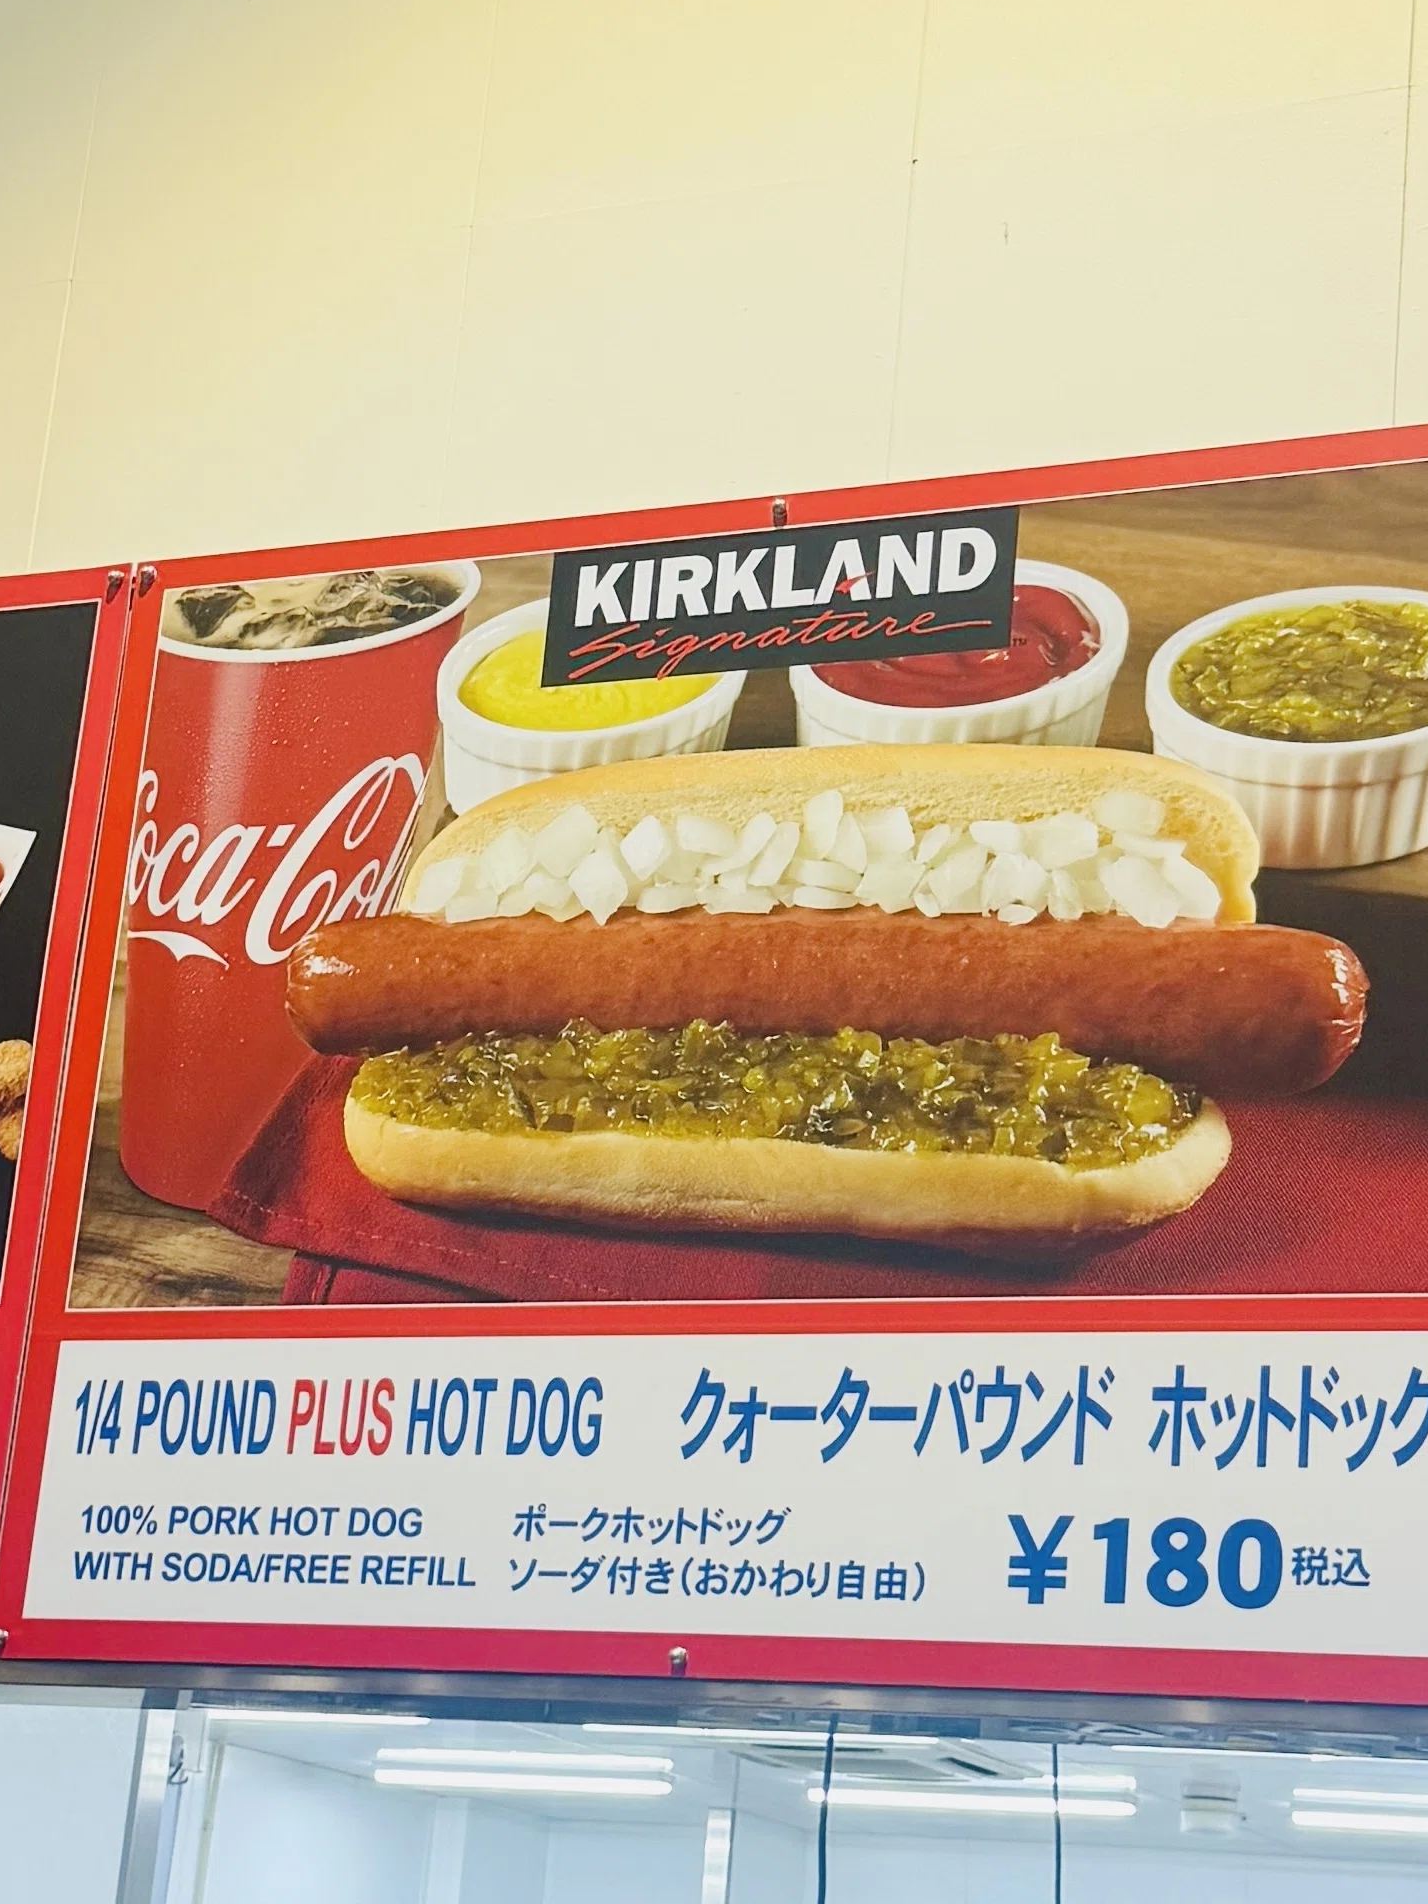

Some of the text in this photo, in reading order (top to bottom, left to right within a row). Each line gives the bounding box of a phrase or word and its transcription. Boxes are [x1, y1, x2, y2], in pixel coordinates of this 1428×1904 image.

[574, 527, 997, 627] KIRKLAND
[568, 609, 992, 681] Signature
[76, 1377, 603, 1456] 1/4 POUND PLUS HOT DOG
[681, 1366, 1114, 1465] クォーターパウンド
[82, 1505, 422, 1537] 100% PORK HOT DOG
[513, 1504, 791, 1546] ポークホットドッグ
[75, 1552, 475, 1586] WITH SODA/FREE REFILL
[1008, 1515, 1370, 1609] ¥180 税込
